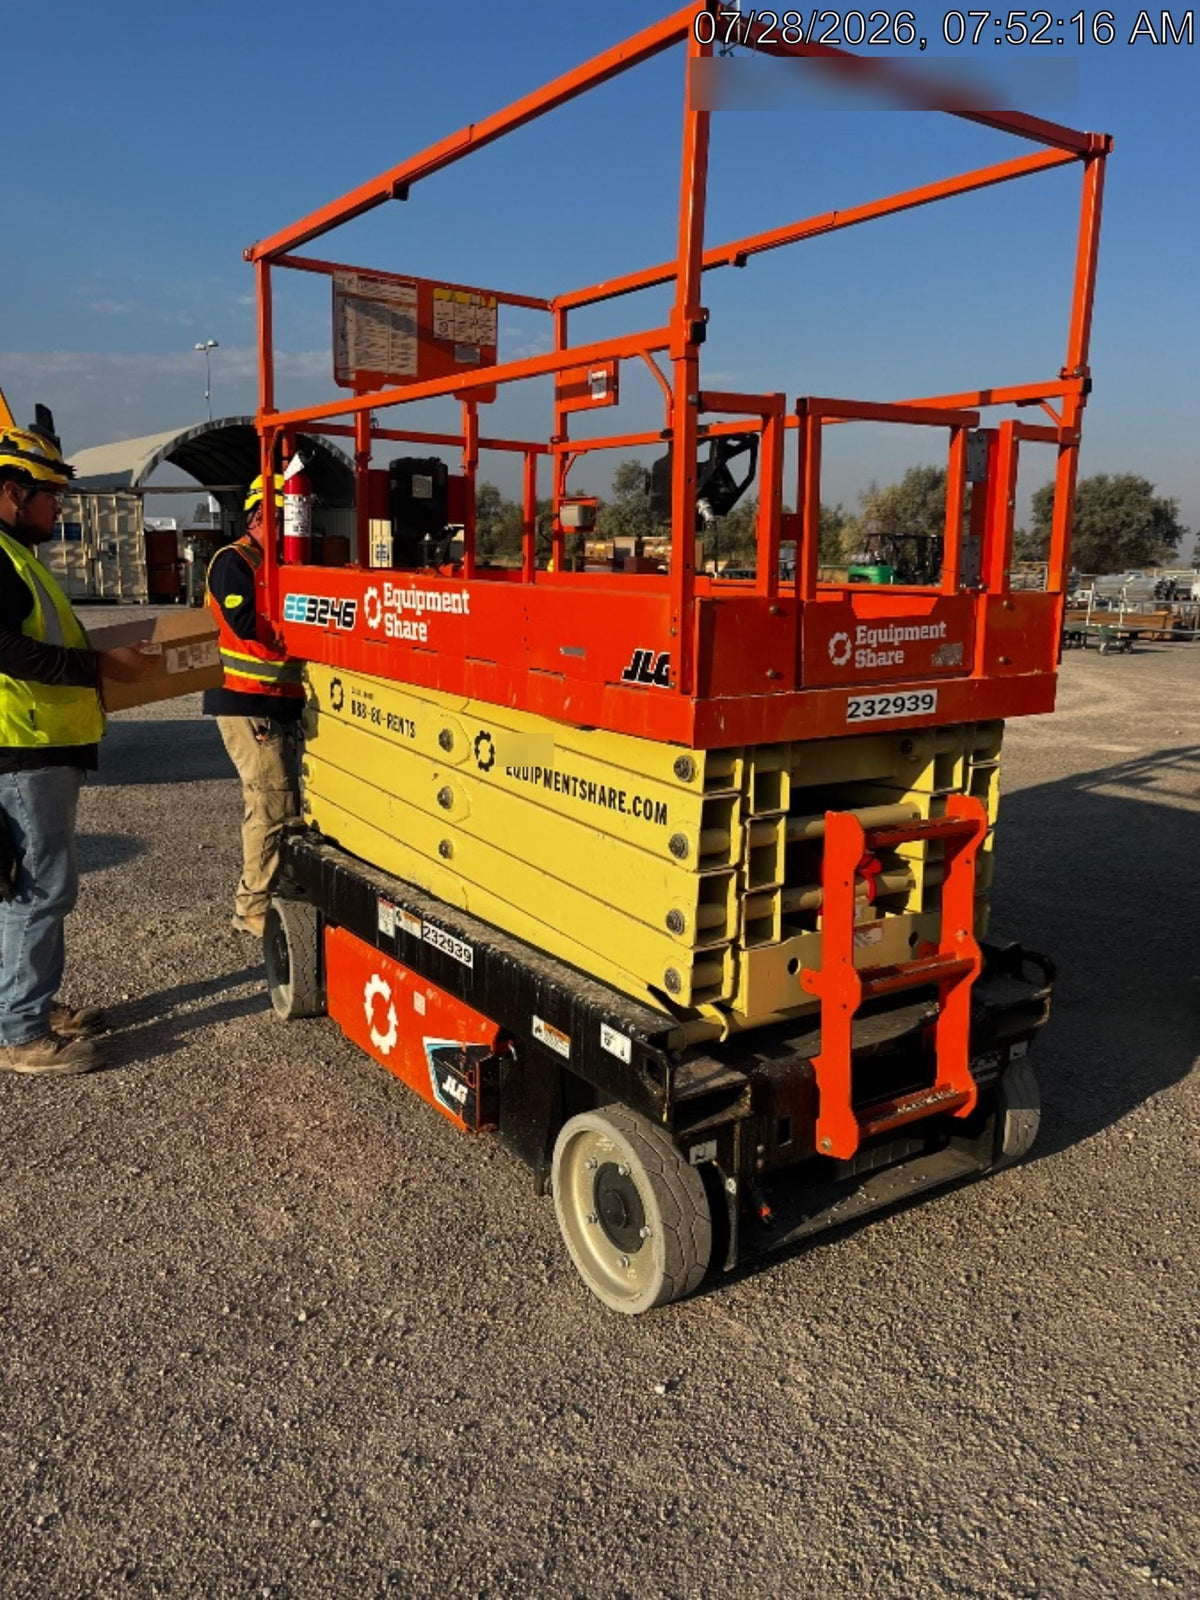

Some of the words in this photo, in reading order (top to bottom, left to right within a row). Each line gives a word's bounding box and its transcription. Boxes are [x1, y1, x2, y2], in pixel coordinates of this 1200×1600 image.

[285, 594, 357, 629] ES3246
[383, 583, 470, 615] Equipment
[384, 613, 428, 642] Share
[855, 621, 947, 648] Equipment
[855, 648, 905, 668] Share
[847, 693, 935, 719] 232939
[423, 925, 472, 963] 232939
[442, 1075, 469, 1104] JLG
